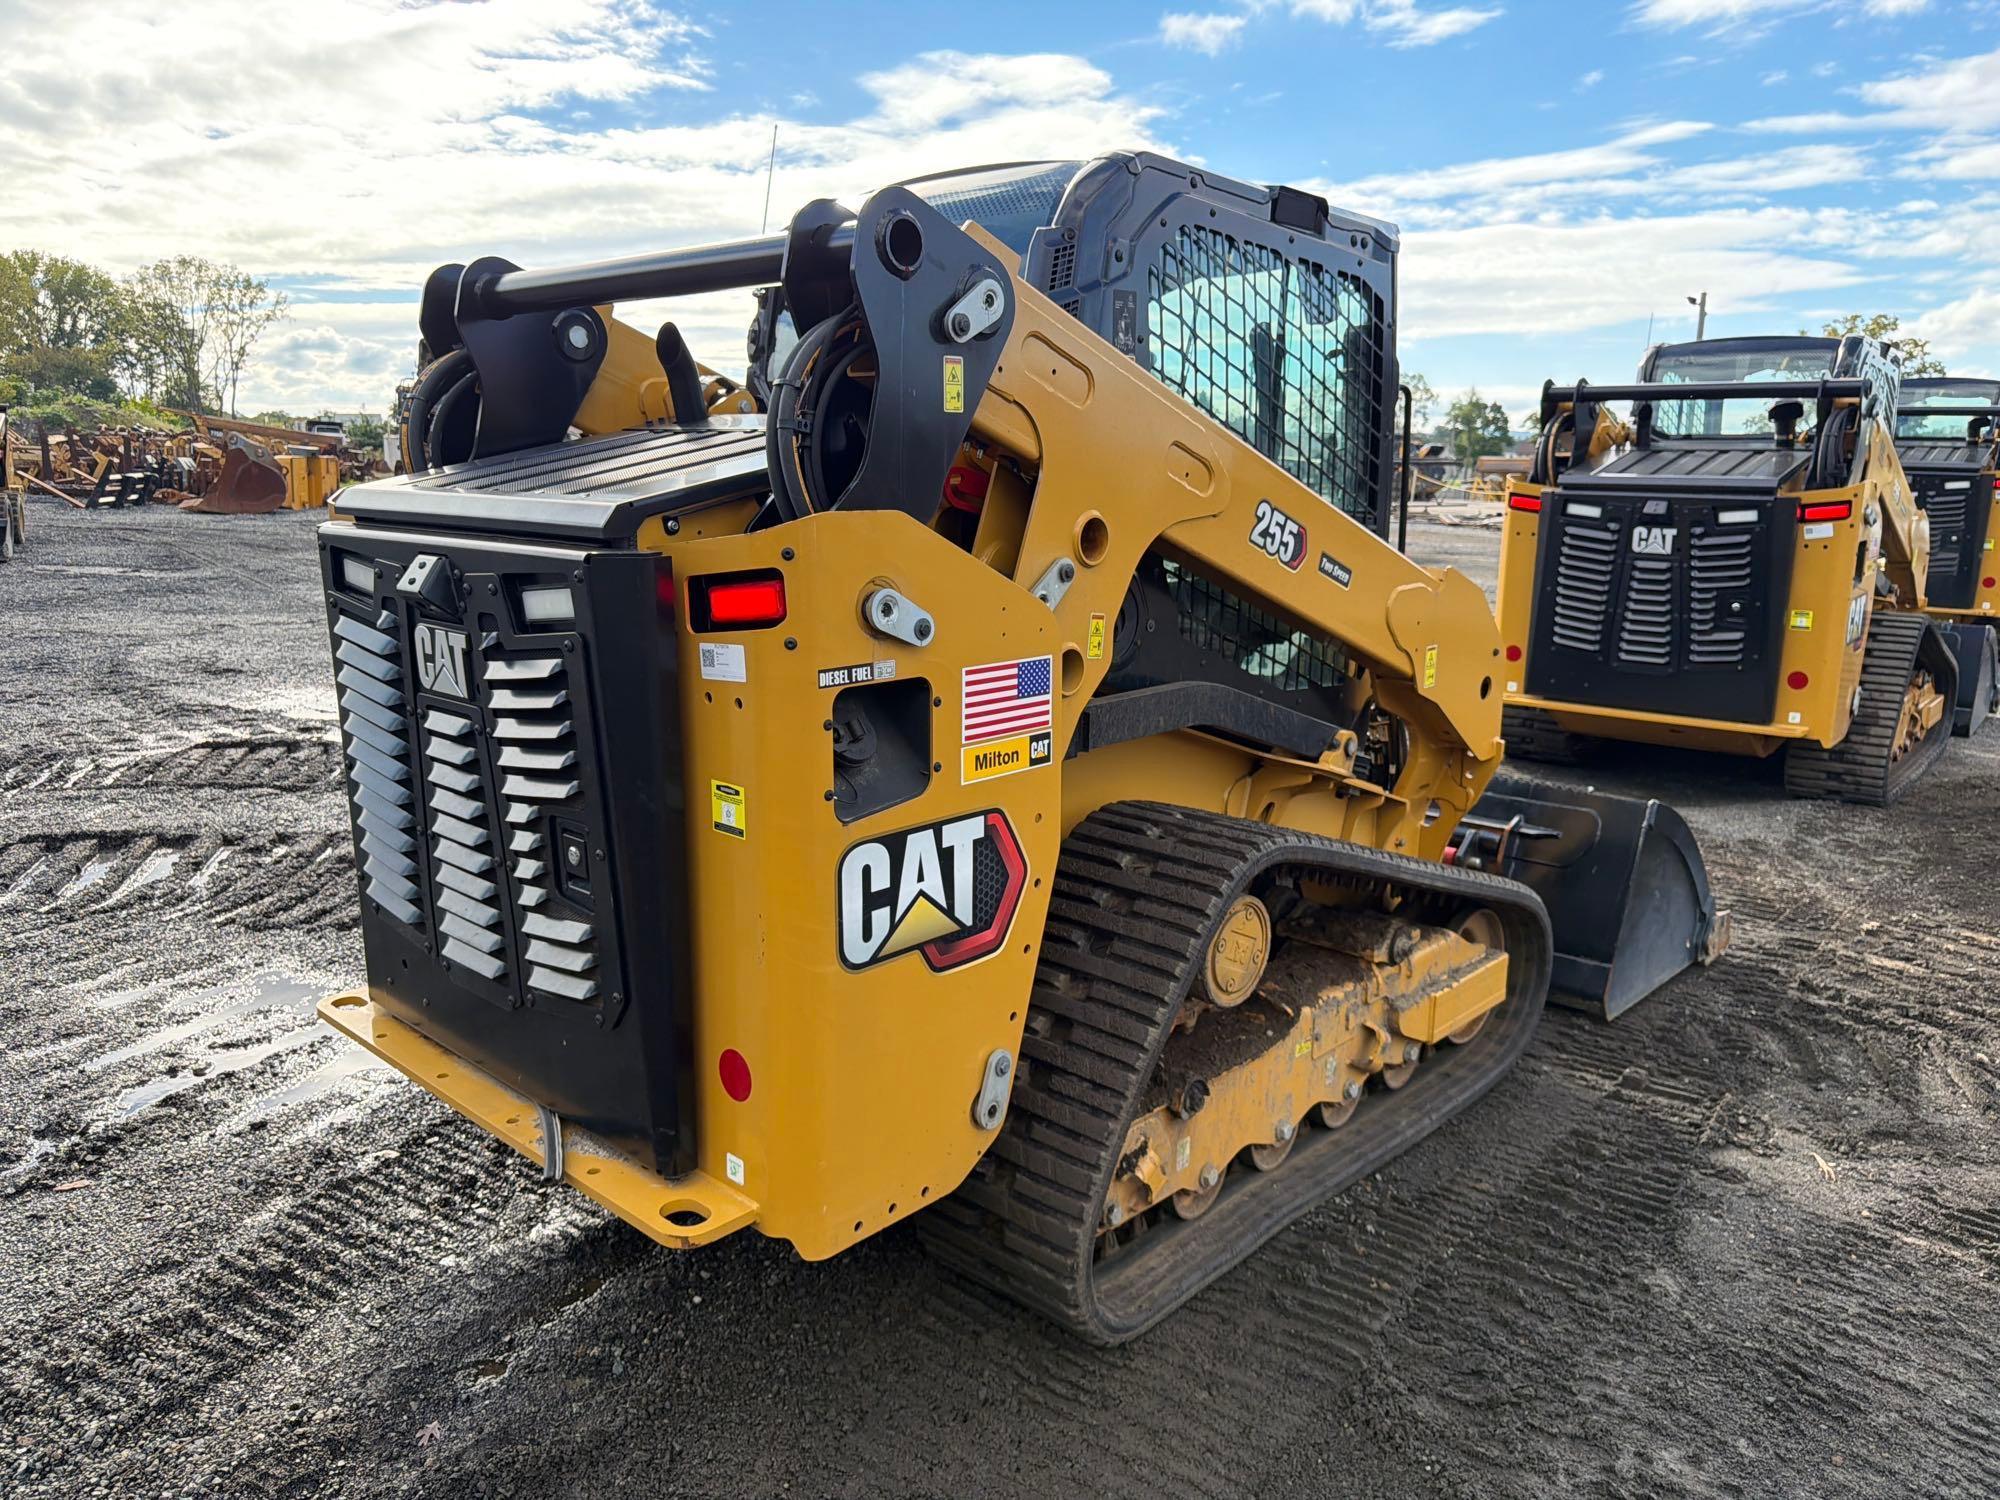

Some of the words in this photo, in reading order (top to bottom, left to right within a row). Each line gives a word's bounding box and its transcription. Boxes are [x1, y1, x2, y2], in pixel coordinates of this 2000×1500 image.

[1250, 501, 1300, 563] 255
[1631, 526, 1678, 555] CAT
[414, 624, 469, 699] CAT
[819, 669, 850, 687] DIESEL
[852, 666, 873, 682] FUEL
[974, 750, 1020, 771] Milton
[1030, 739, 1050, 759] CAT
[841, 815, 985, 964] CAT
